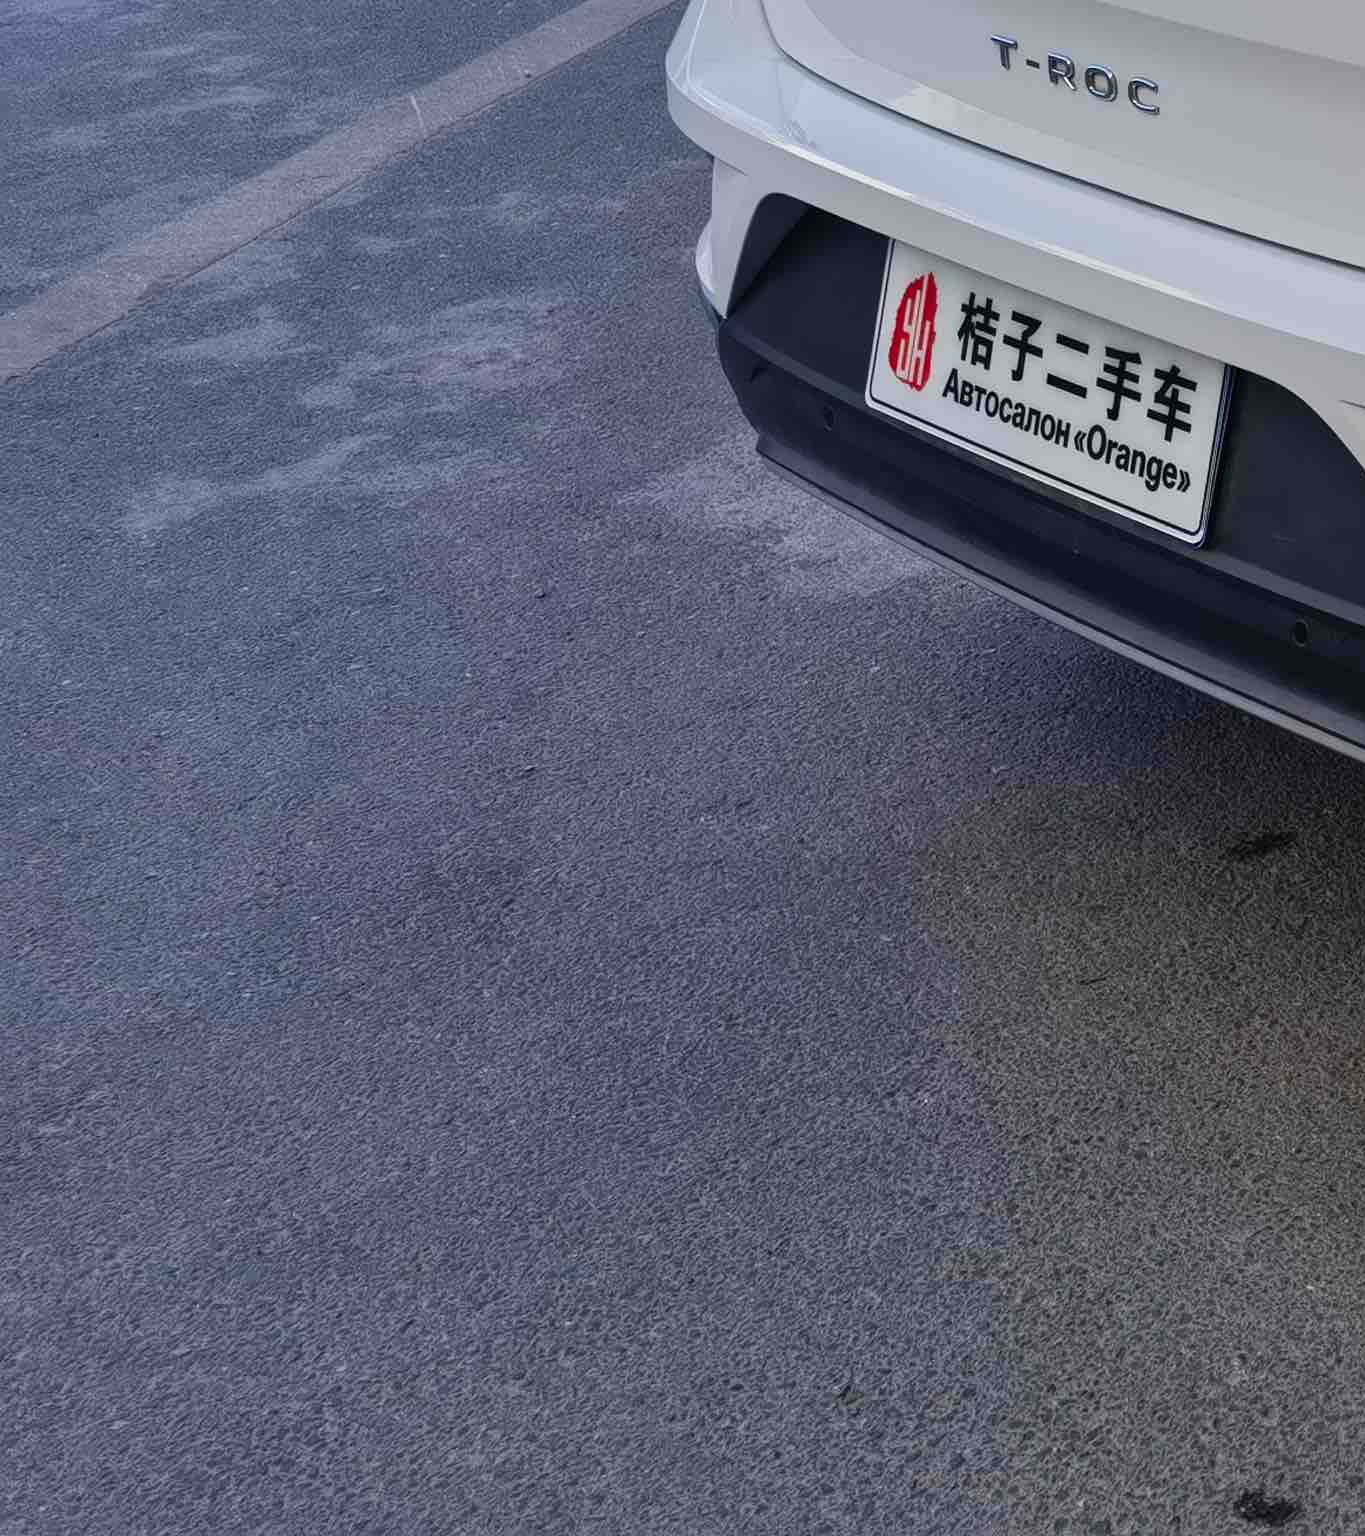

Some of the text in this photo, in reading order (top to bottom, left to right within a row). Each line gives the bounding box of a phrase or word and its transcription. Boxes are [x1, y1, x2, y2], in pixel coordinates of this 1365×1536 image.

[990, 34, 1161, 115] T-ROC
[957, 291, 1198, 442] 桔子二手车
[942, 368, 1192, 494] Автосалон «Orange»
